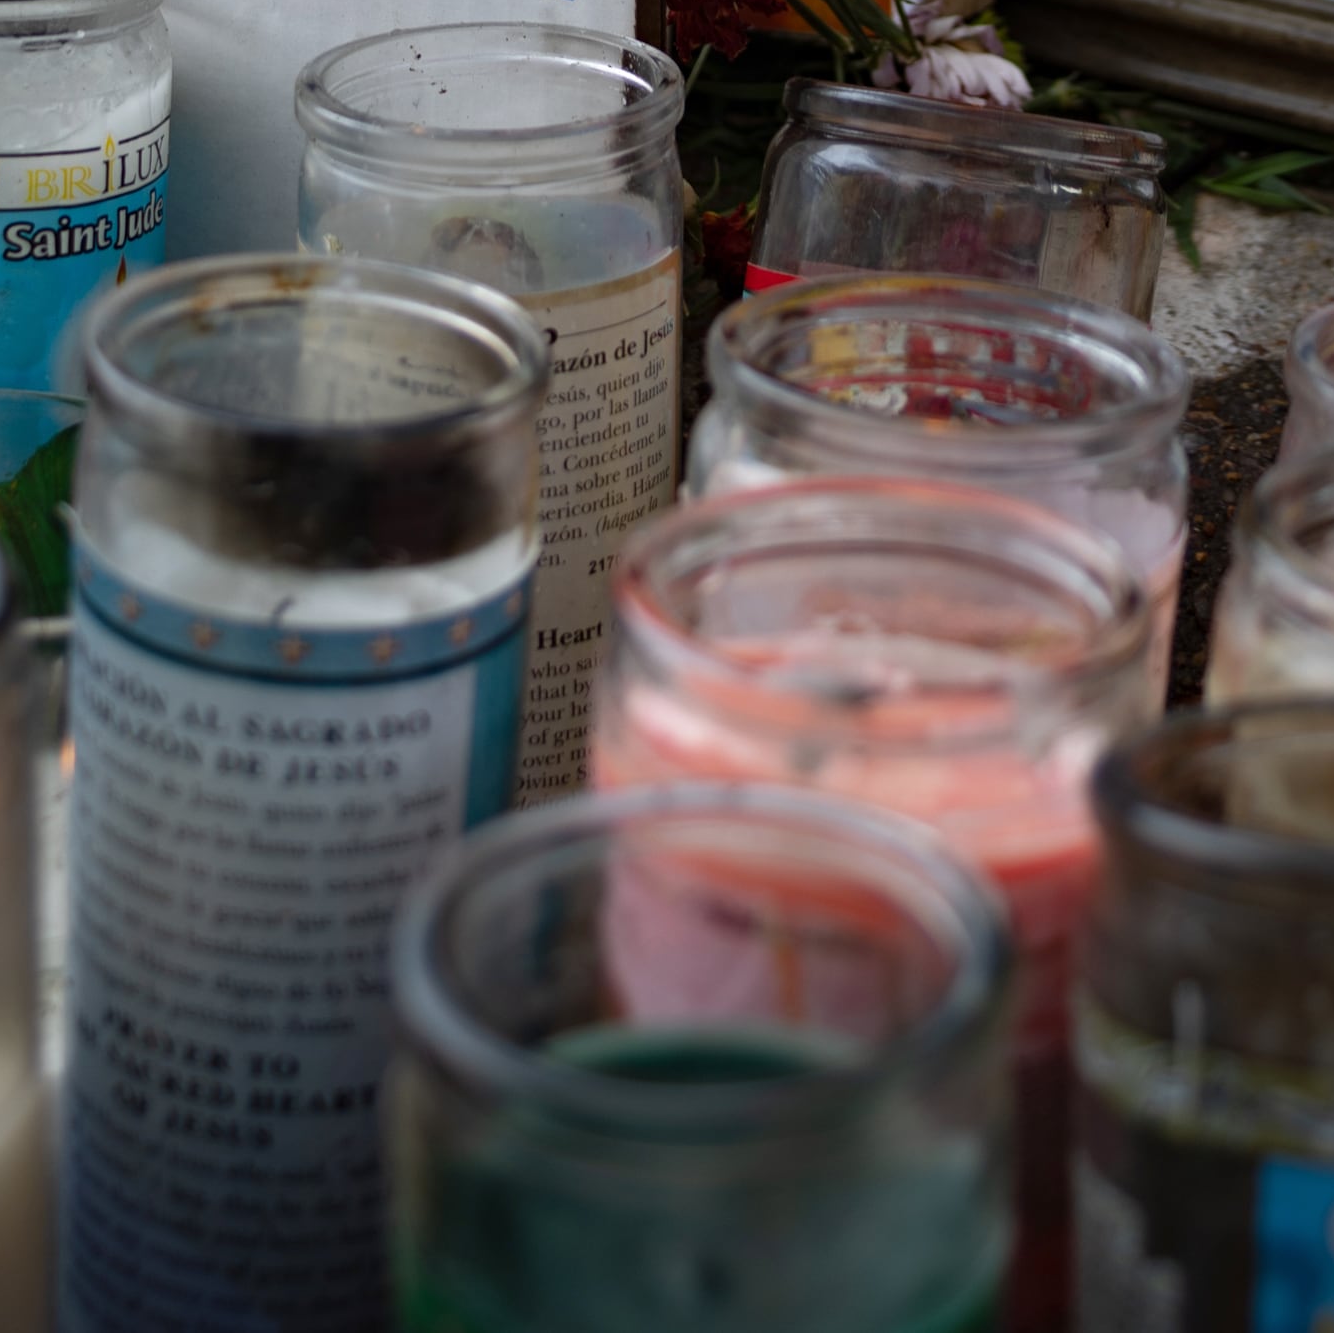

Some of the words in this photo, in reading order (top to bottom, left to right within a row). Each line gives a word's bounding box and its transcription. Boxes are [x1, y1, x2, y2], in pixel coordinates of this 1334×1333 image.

[4, 215, 113, 262] Saint
[116, 189, 165, 249] Jude
[613, 337, 637, 361] de
[640, 316, 674, 358] Jesús
[596, 372, 640, 401] quien
[644, 356, 665, 381] dijo
[572, 406, 604, 430] por
[609, 398, 629, 416] las
[633, 377, 669, 407] llamas
[538, 422, 631, 454] encienden
[636, 412, 649, 428] tu
[563, 431, 655, 472] Concédeme
[658, 422, 666, 439] la
[575, 471, 621, 494] sobre
[625, 459, 643, 478] mi
[647, 449, 663, 468] tus
[595, 504, 646, 538] (hágase
[648, 495, 658, 513] la
[536, 620, 603, 650] Heart
[529, 683, 567, 702] that
[573, 678, 592, 698] by
[531, 661, 570, 680] who
[241, 708, 433, 746] SAGRADO
[527, 727, 550, 746] of
[522, 750, 564, 769] over
